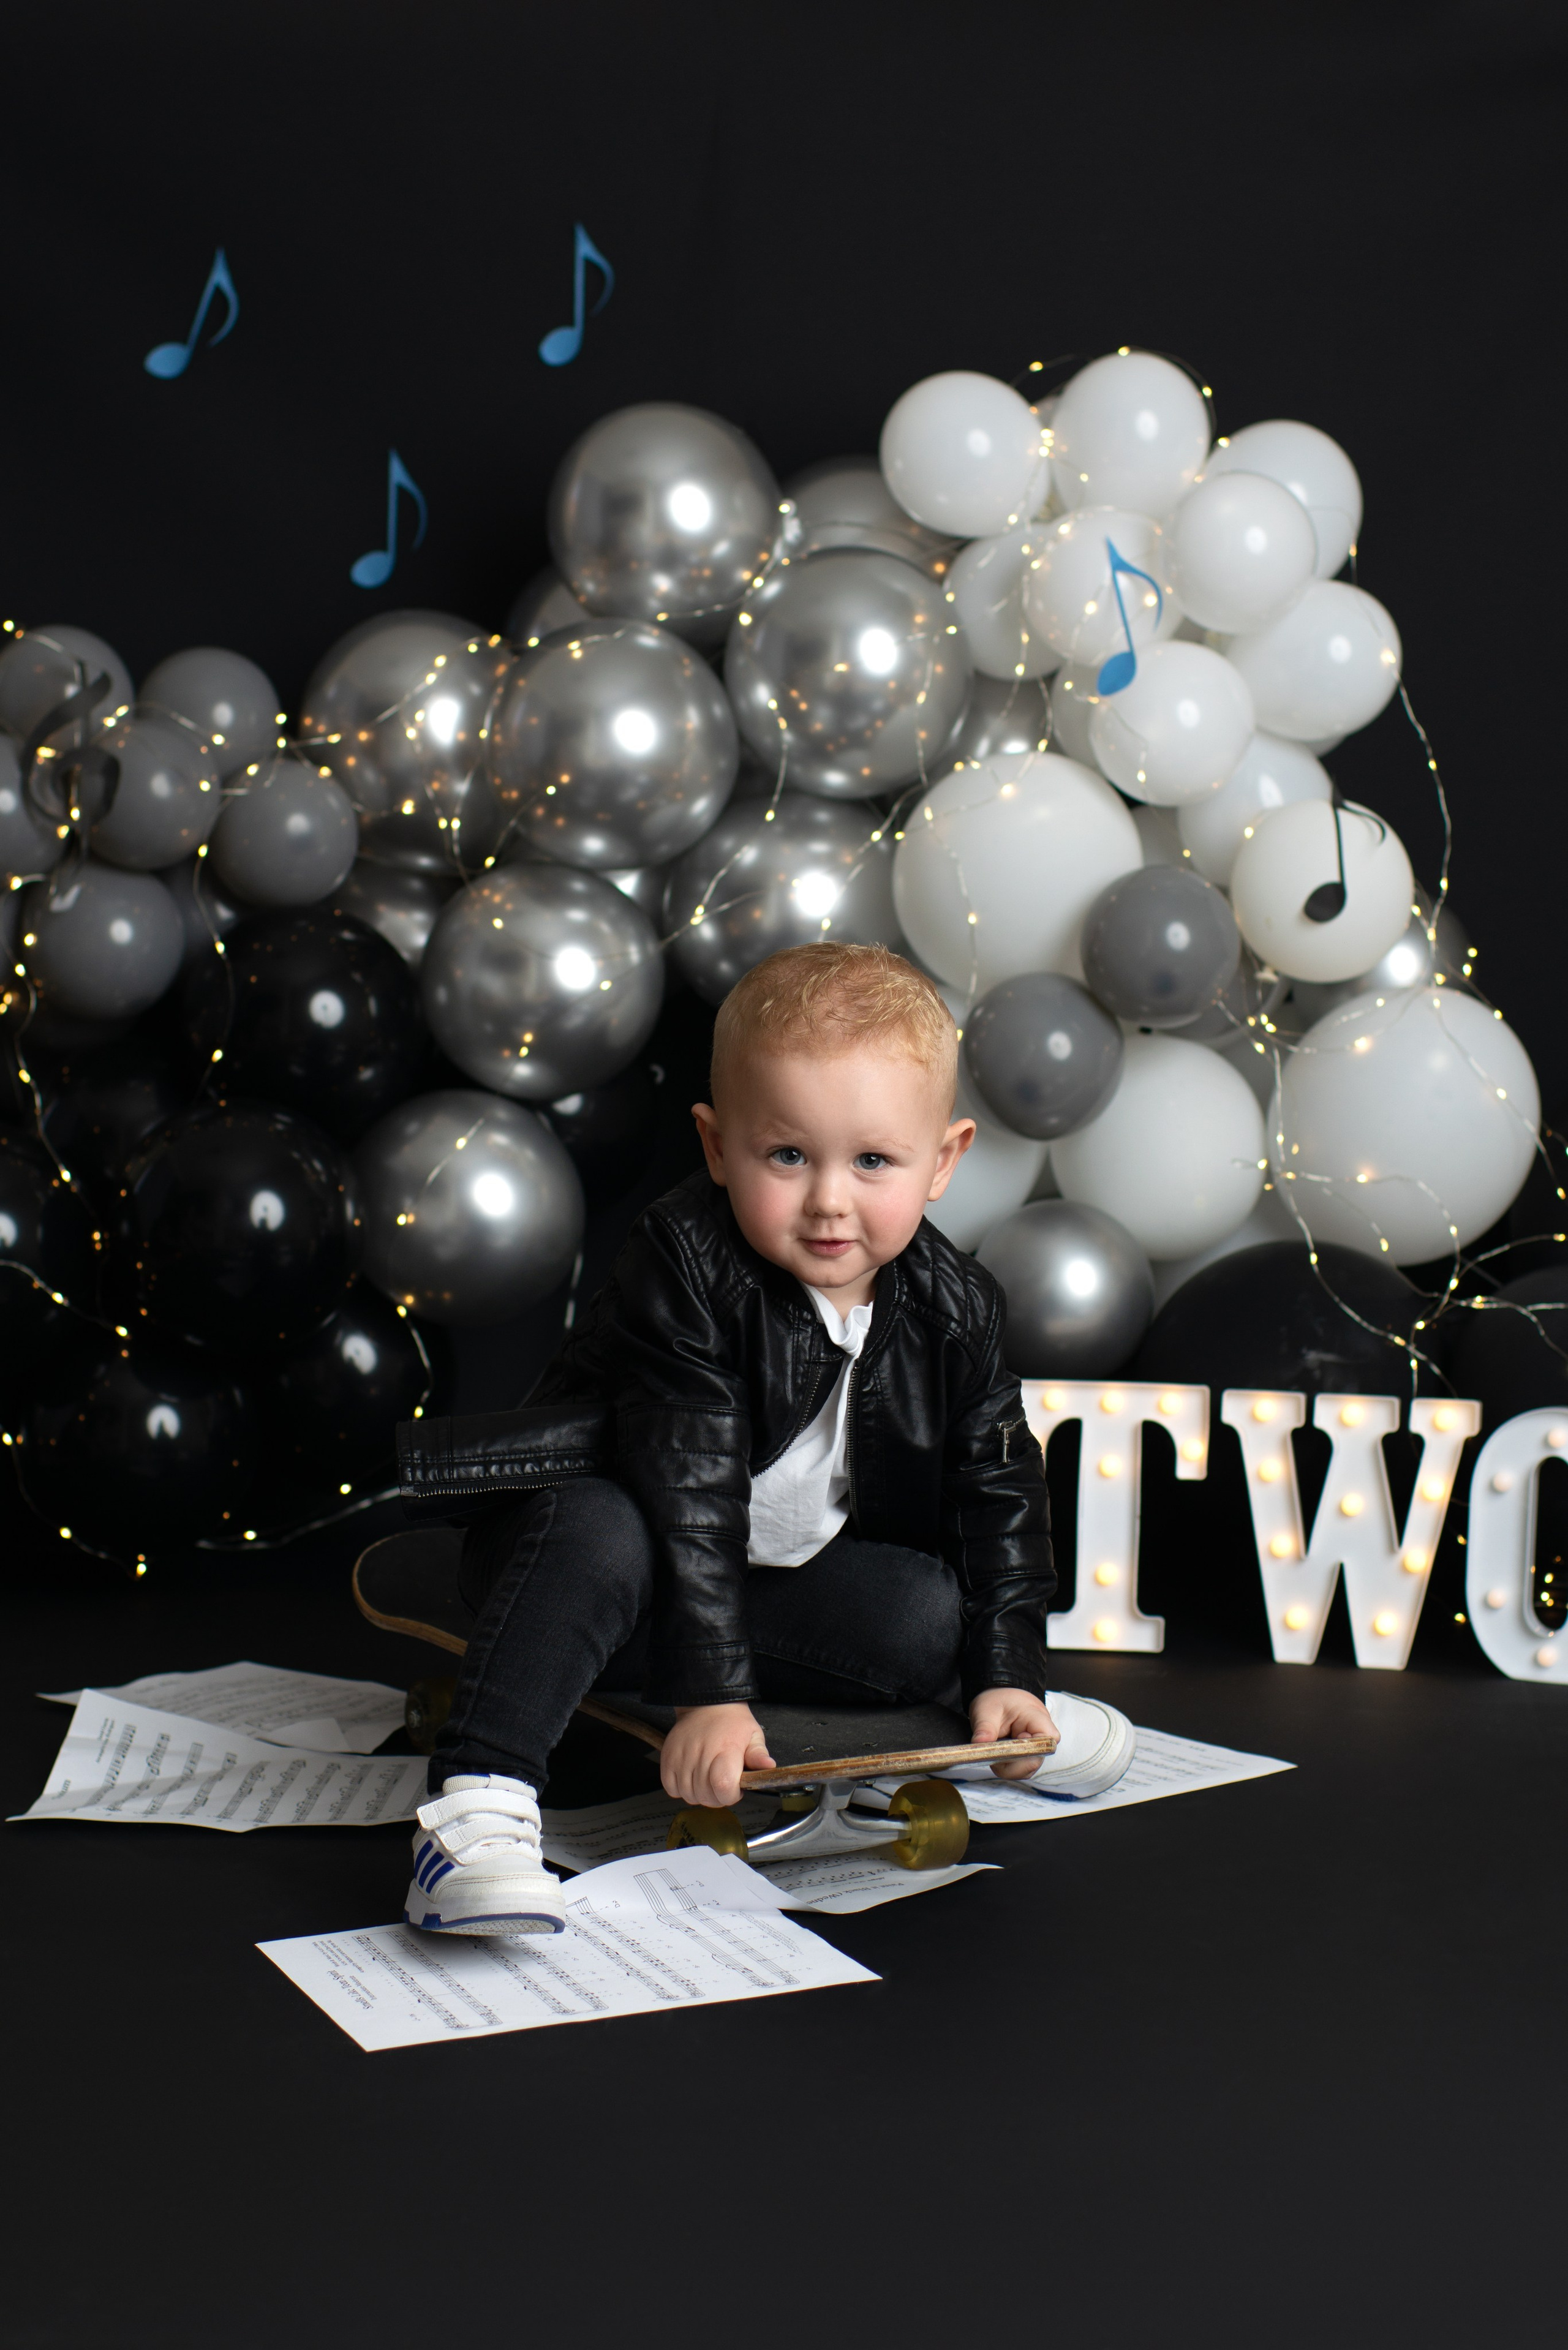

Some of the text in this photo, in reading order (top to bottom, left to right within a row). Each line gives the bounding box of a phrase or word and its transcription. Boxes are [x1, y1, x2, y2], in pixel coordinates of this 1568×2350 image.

[1021, 1379, 1568, 1684] TWO
[326, 1970, 374, 2009] Smells Like Teen Spirit
